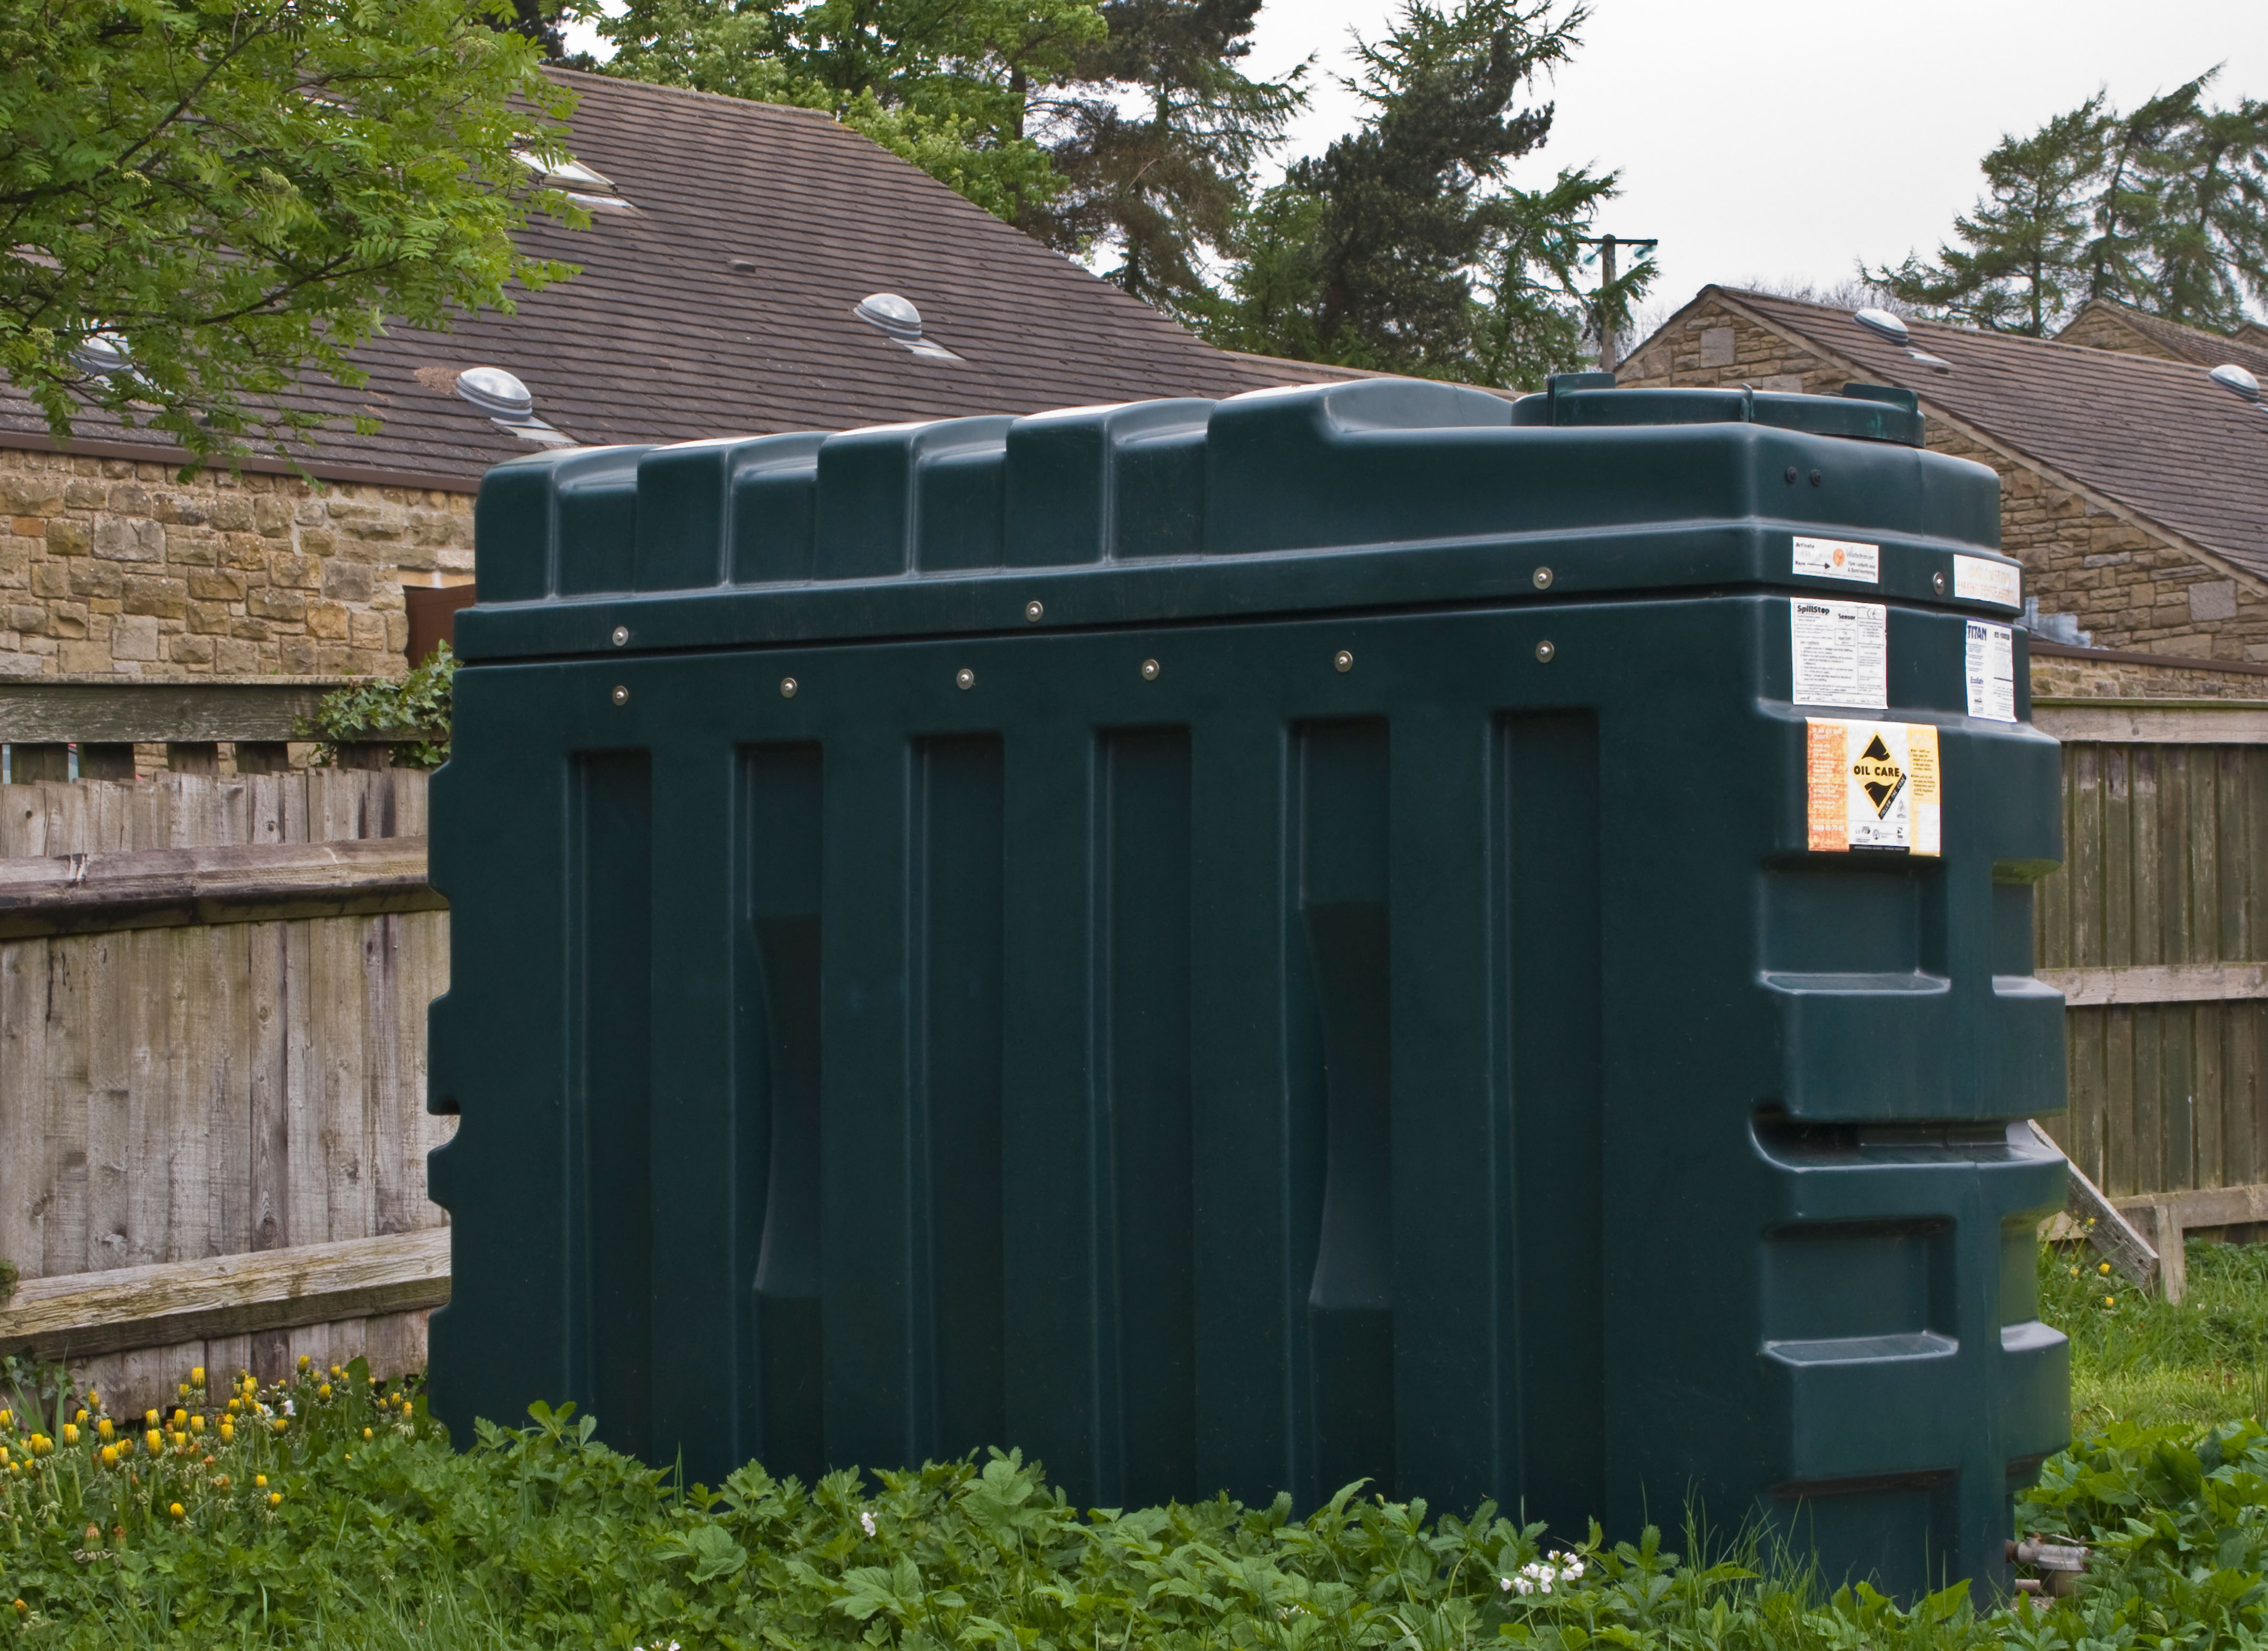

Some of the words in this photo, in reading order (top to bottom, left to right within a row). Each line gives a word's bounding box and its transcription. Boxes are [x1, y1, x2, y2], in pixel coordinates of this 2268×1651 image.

[1797, 605, 1830, 615] SpillStop
[1967, 625, 1987, 641] TITAN
[1854, 765, 1870, 775] OIL
[1875, 767, 1900, 777] CARE
[1880, 799, 1891, 817] FOLLOW
